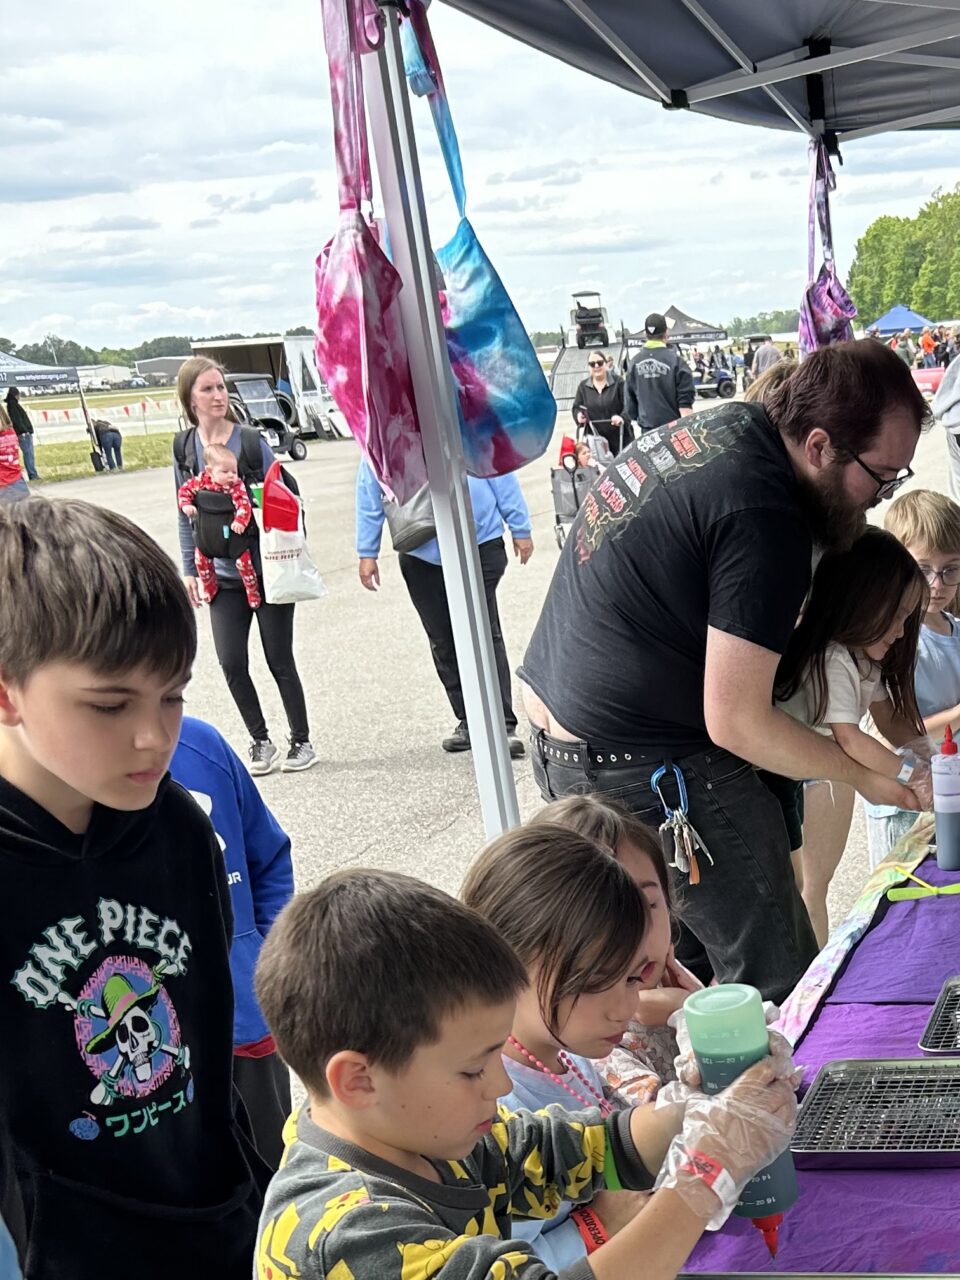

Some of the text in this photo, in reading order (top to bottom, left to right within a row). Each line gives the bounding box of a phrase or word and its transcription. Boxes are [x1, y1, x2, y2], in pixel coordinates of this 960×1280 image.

[10, 896, 193, 1009] ONE PIECE
[105, 1091, 187, 1137] ワンピース
